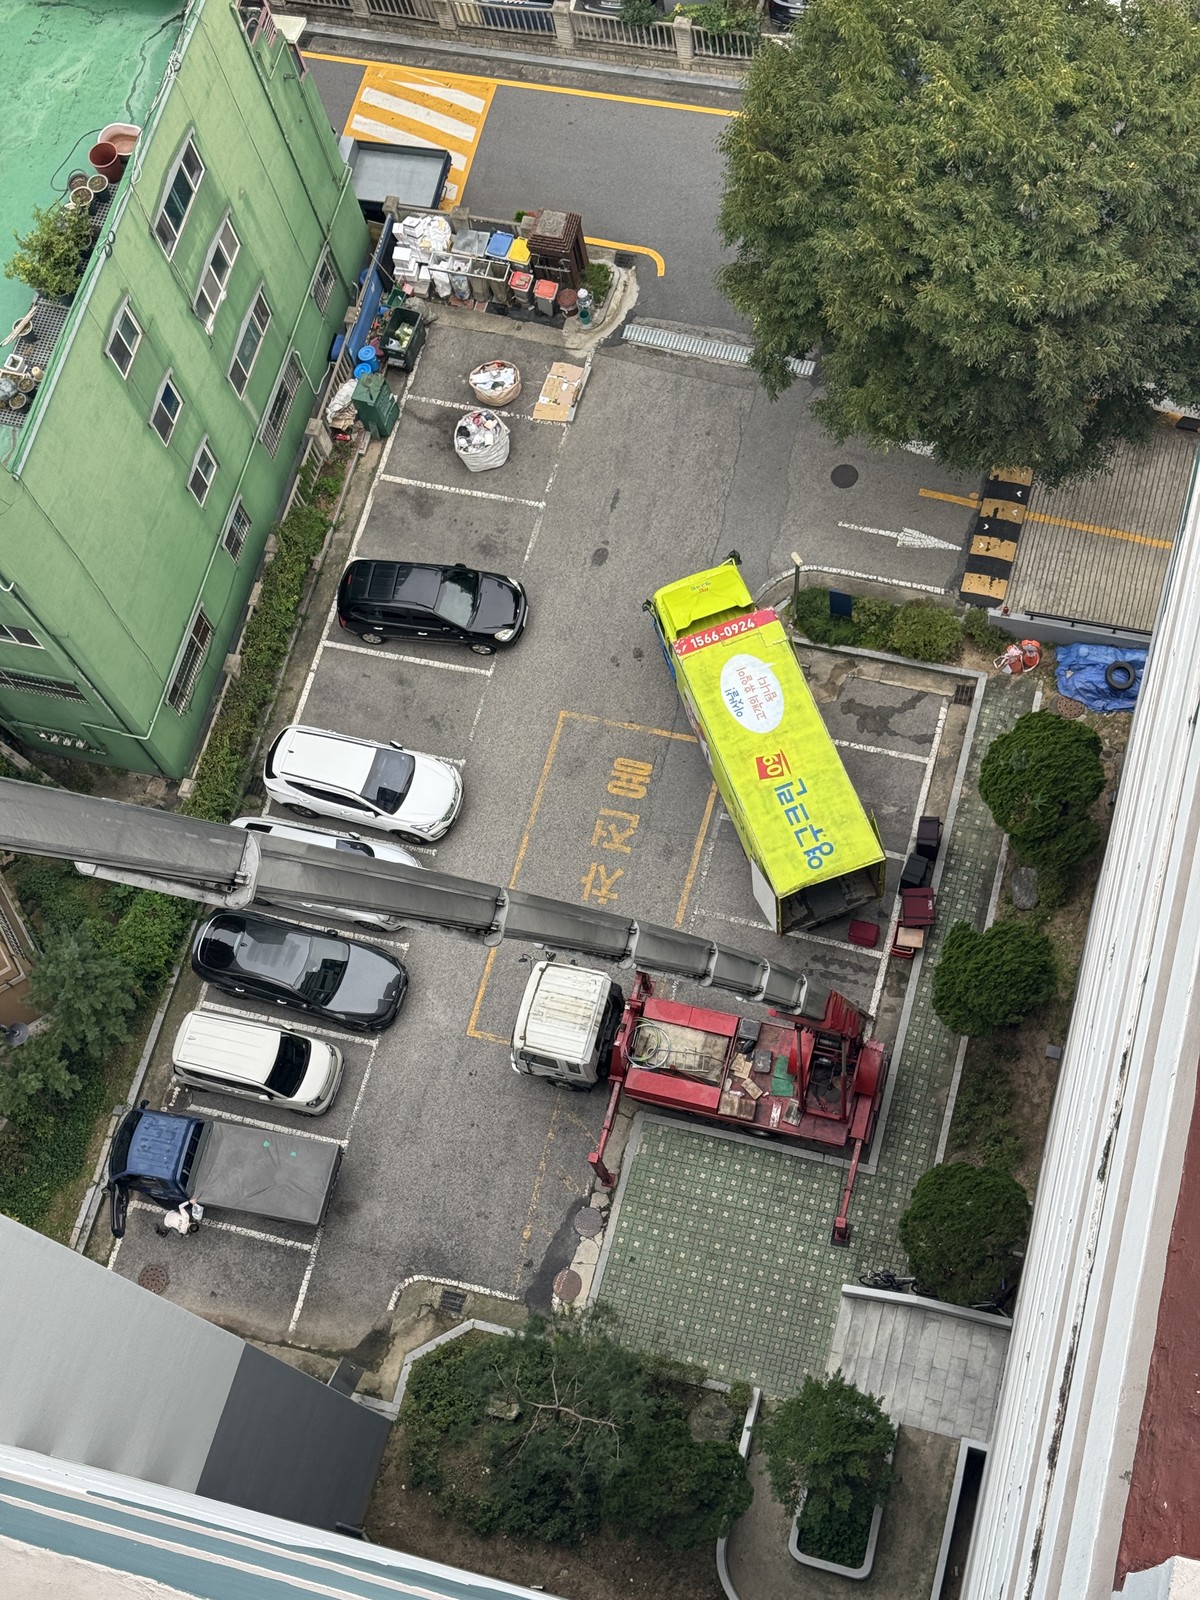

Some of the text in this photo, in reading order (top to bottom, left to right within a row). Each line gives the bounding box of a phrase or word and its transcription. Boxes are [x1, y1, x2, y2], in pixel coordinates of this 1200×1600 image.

[690, 618, 755, 648] 1566-0924
[724, 687, 744, 718] 이삿날!
[736, 666, 767, 720] 고객의 휴일이
[757, 676, 778, 702] 됩니다
[773, 777, 834, 870] 영구크린
